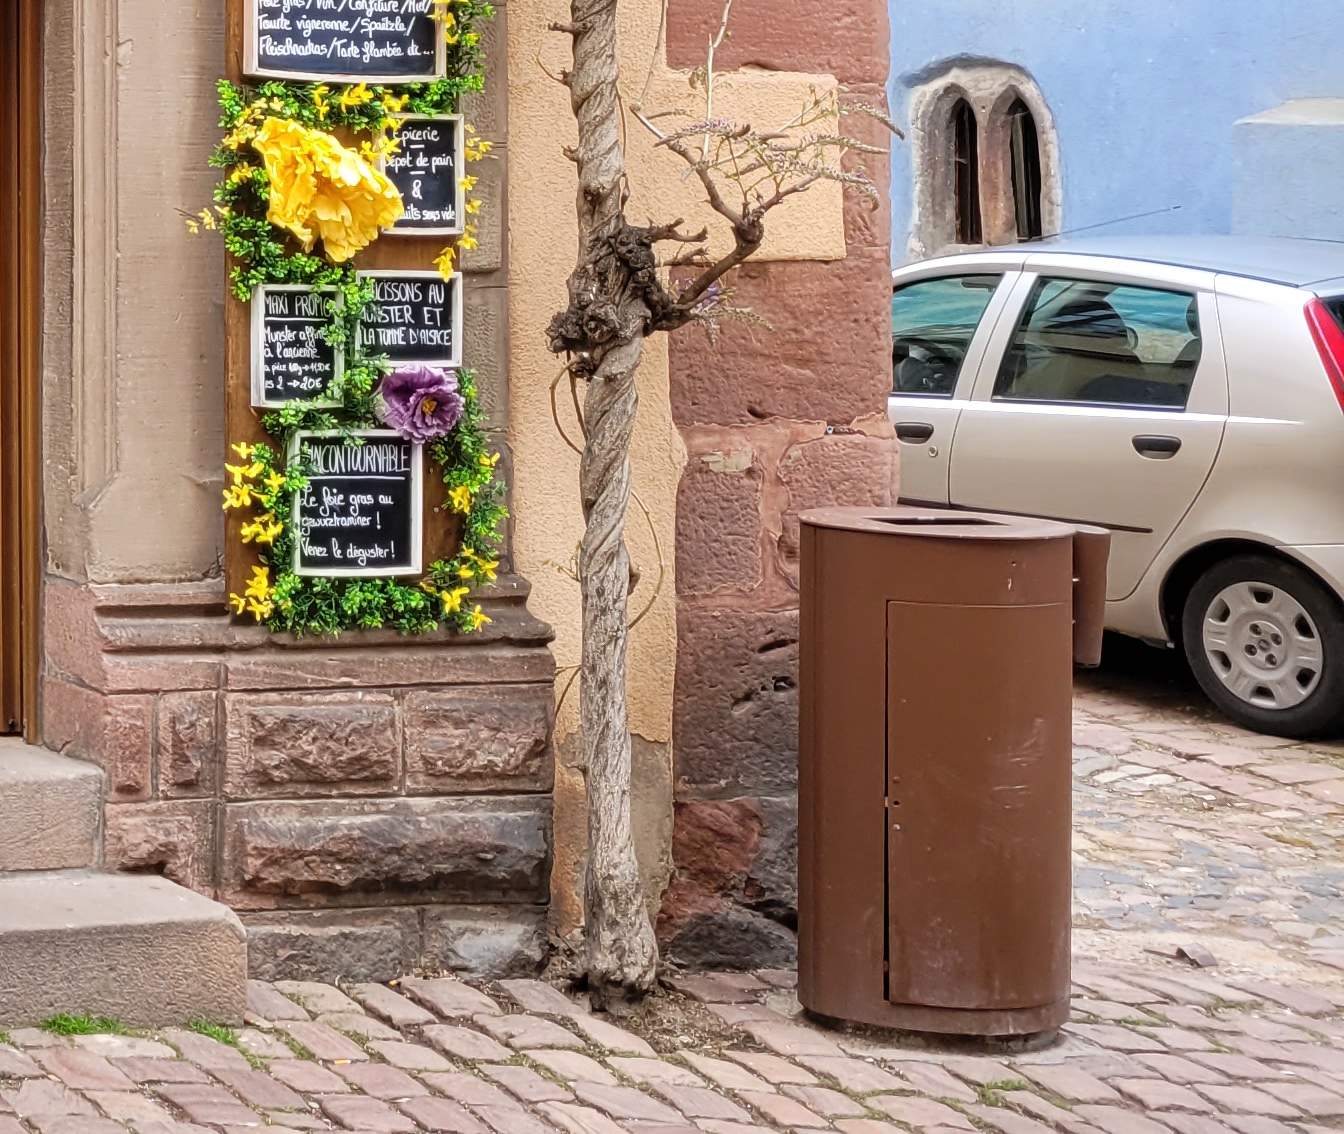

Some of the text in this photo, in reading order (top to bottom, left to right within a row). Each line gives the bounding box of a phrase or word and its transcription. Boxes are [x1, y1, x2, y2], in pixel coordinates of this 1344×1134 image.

[258, 11, 293, 31] Tourte
[416, 151, 430, 166] de
[431, 153, 454, 174] pain
[412, 179, 423, 200] &
[441, 203, 456, 221] vide
[264, 293, 289, 316] MAXI
[428, 283, 445, 305] AU
[422, 306, 444, 327] ET
[264, 324, 296, 344] Munster
[300, 484, 394, 517] Le foie gras au
[300, 536, 329, 557] Venez
[331, 537, 343, 559] le
